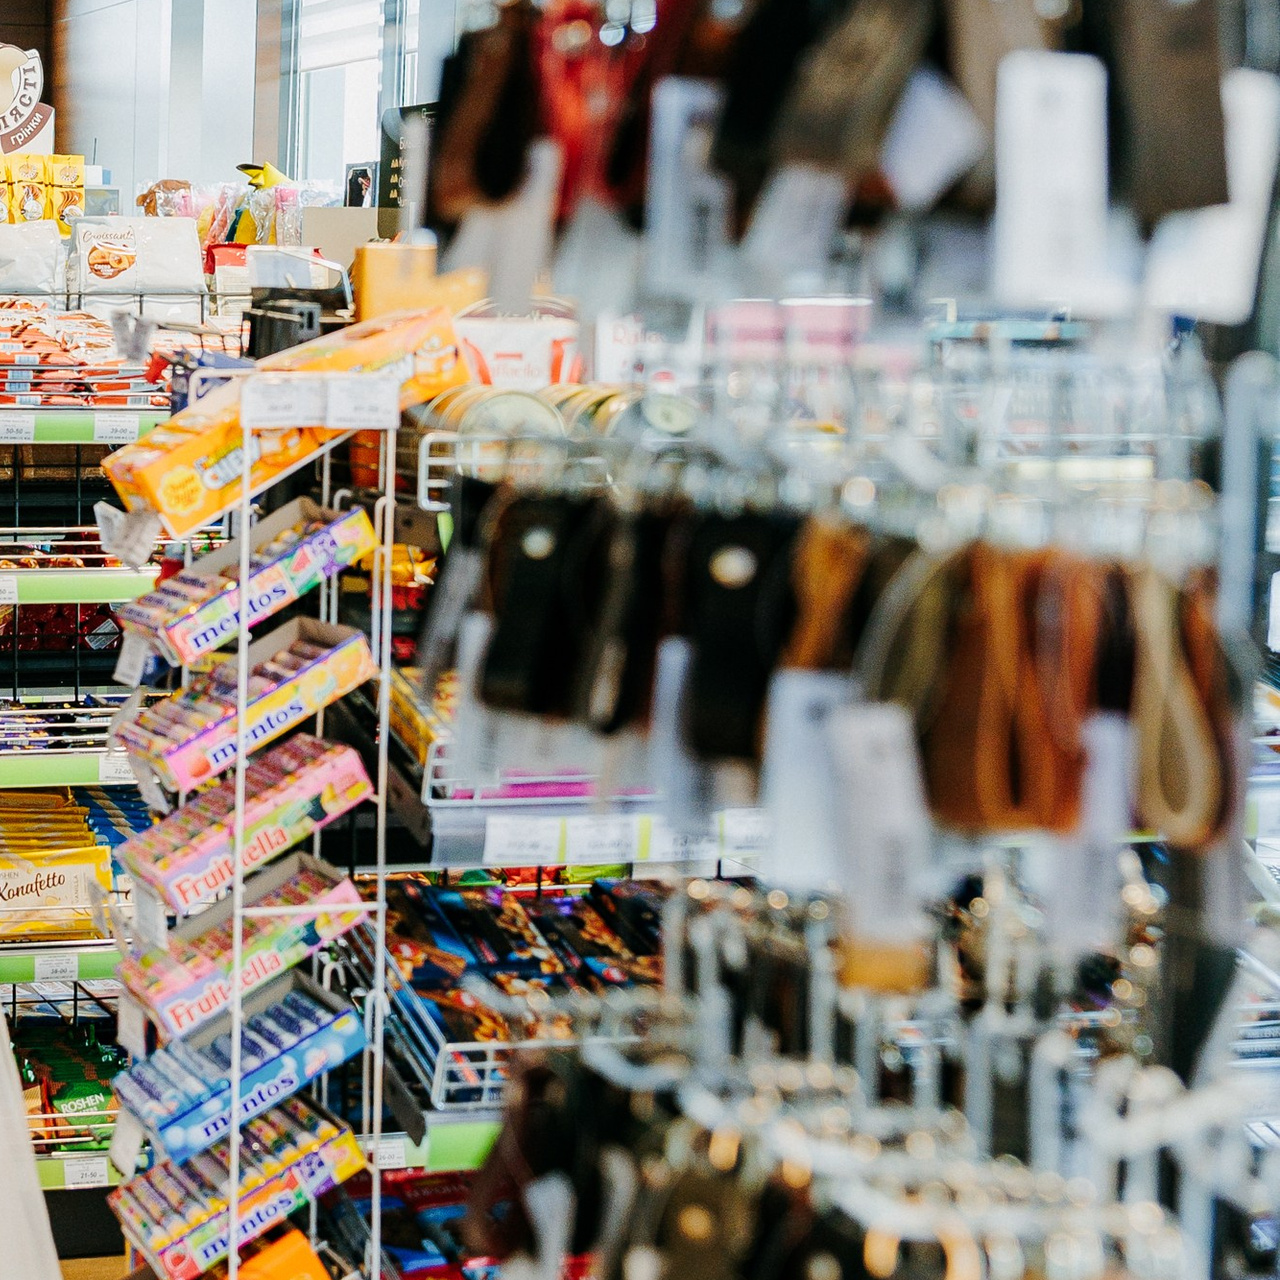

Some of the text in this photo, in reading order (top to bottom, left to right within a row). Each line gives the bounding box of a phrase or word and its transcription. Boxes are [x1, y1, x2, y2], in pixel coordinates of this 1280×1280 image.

[11, 112, 43, 145] грінки
[212, 699, 304, 764] mntos
[175, 827, 288, 905] Fruitella
[169, 951, 282, 1030] Fruitella
[61, 1092, 105, 1114] ROSHEN
[202, 1075, 296, 1138] mntos
[202, 1195, 294, 1260] mntos
